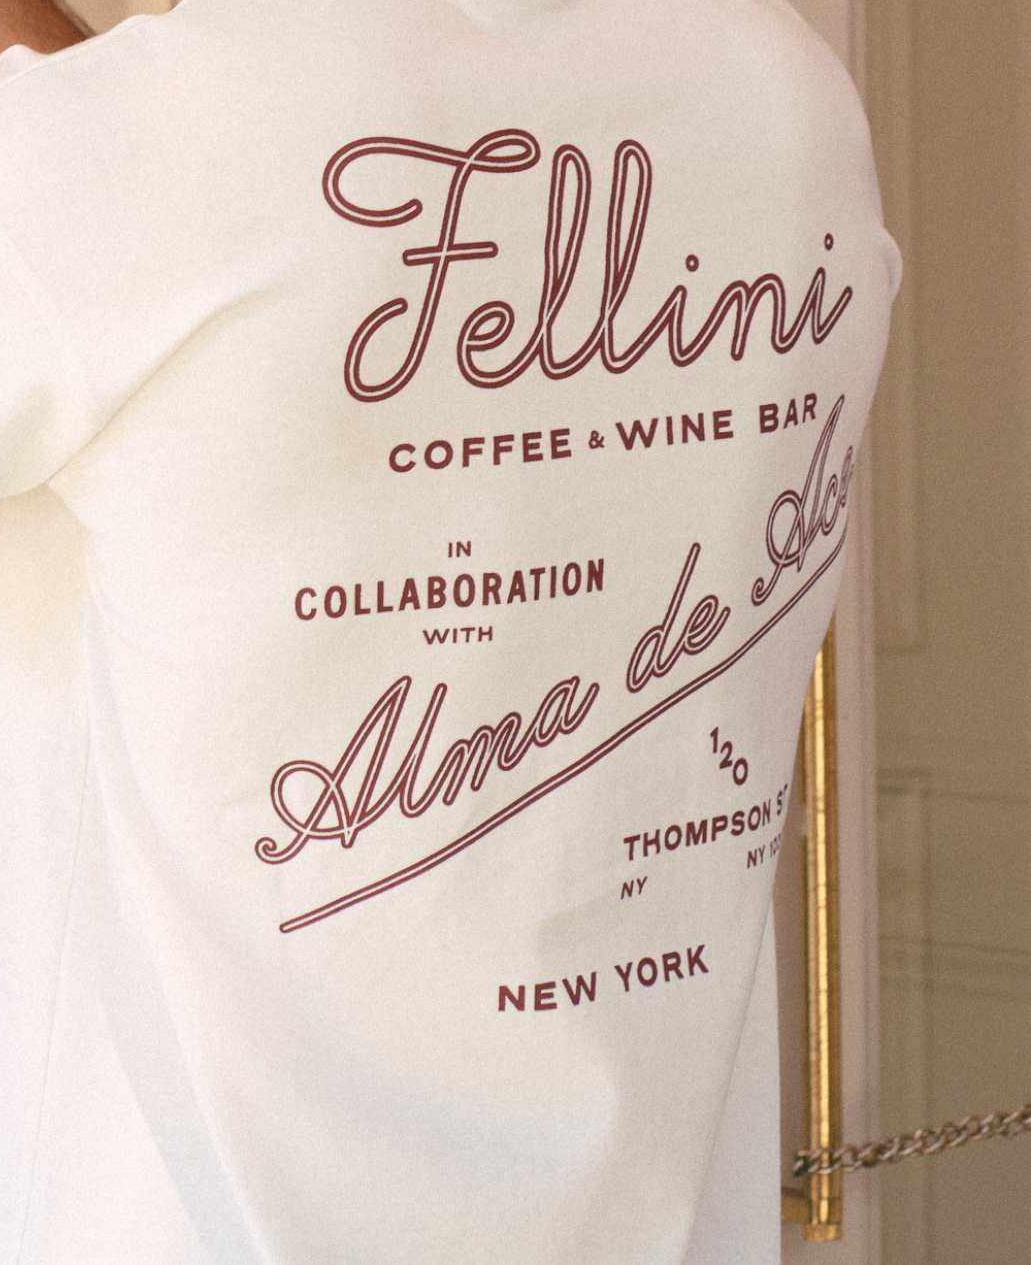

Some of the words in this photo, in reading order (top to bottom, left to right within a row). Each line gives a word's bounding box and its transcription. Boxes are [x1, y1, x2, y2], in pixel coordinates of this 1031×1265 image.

[321, 128, 853, 403] Fellini
[388, 427, 573, 474] COFFEE
[587, 429, 606, 451] &
[615, 408, 735, 451] WINE
[758, 392, 818, 434] BAR
[447, 540, 472, 559] IN
[294, 558, 606, 622] COLLABORATION
[421, 625, 494, 646] WITH
[254, 674, 601, 864] Alma
[625, 541, 732, 694] de
[622, 798, 772, 862] THOMPSON
[746, 844, 766, 870] NY
[620, 875, 649, 900] NY
[497, 971, 598, 1013] NEW
[614, 943, 711, 993] YORK
